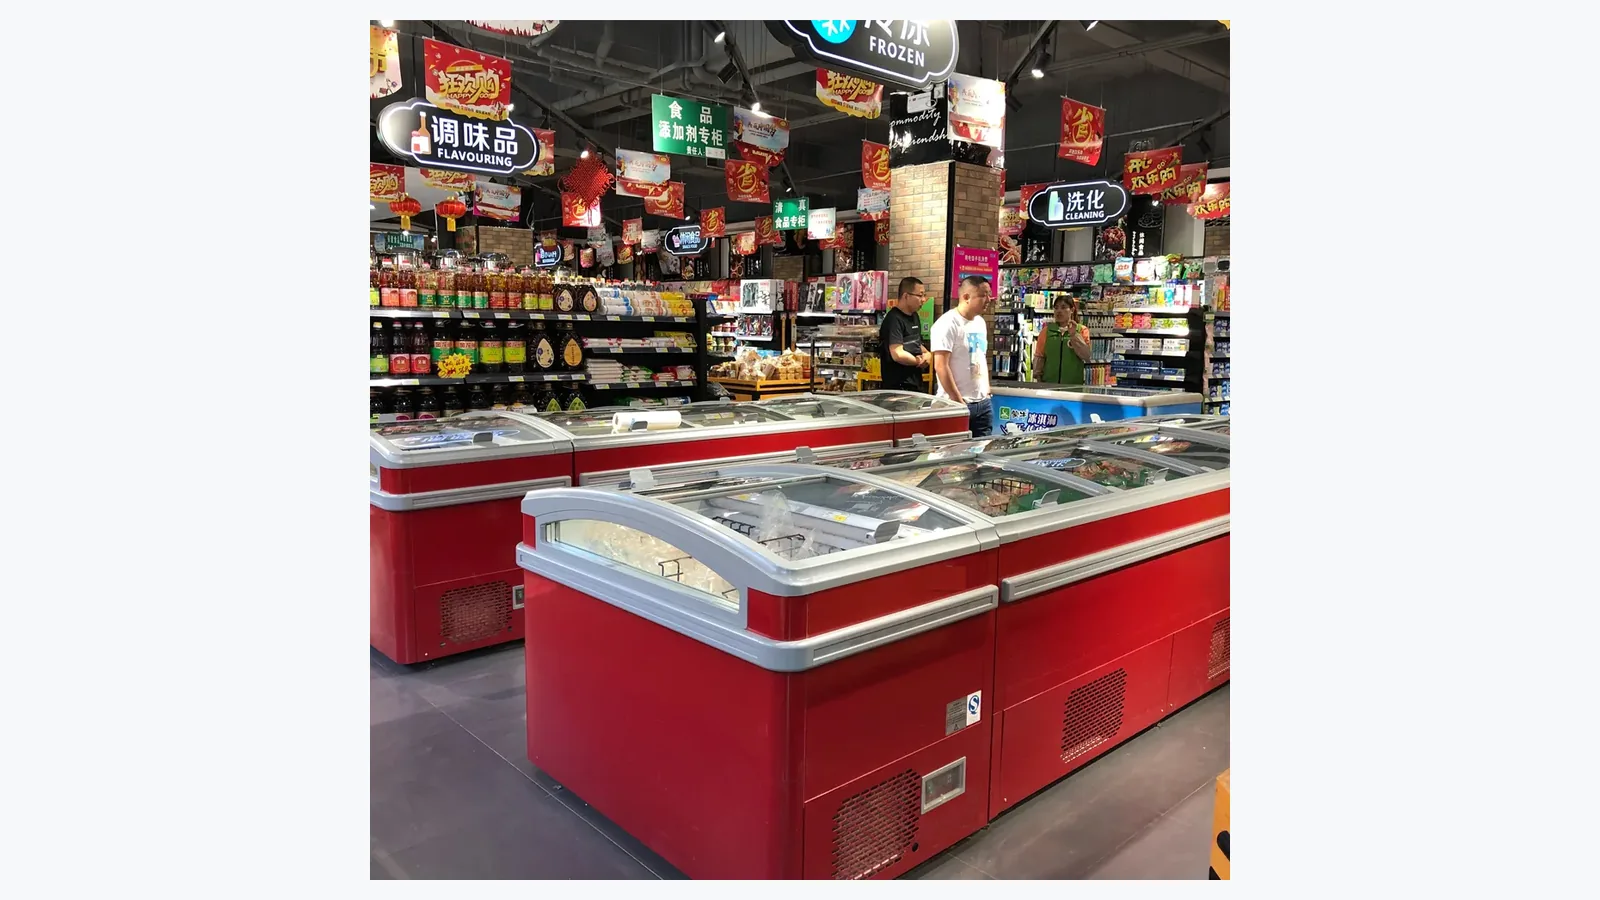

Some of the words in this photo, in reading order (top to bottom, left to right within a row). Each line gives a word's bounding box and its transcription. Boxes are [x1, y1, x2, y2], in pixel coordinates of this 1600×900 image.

[869, 36, 925, 67] FROZEN
[438, 68, 500, 104] 狂欢购
[431, 115, 518, 155] 调味品
[658, 119, 723, 147] 添加剂专柜
[1072, 106, 1094, 144] 省
[437, 147, 513, 167] FLAVOURING
[1127, 155, 1153, 174] 开心
[736, 163, 757, 190] 省
[1129, 167, 1177, 192] 欢乐购
[1066, 189, 1105, 212] 洗化
[1160, 181, 1202, 201] 欢乐购
[774, 215, 806, 229] 食品专柜
[1065, 210, 1105, 220] CLEANING
